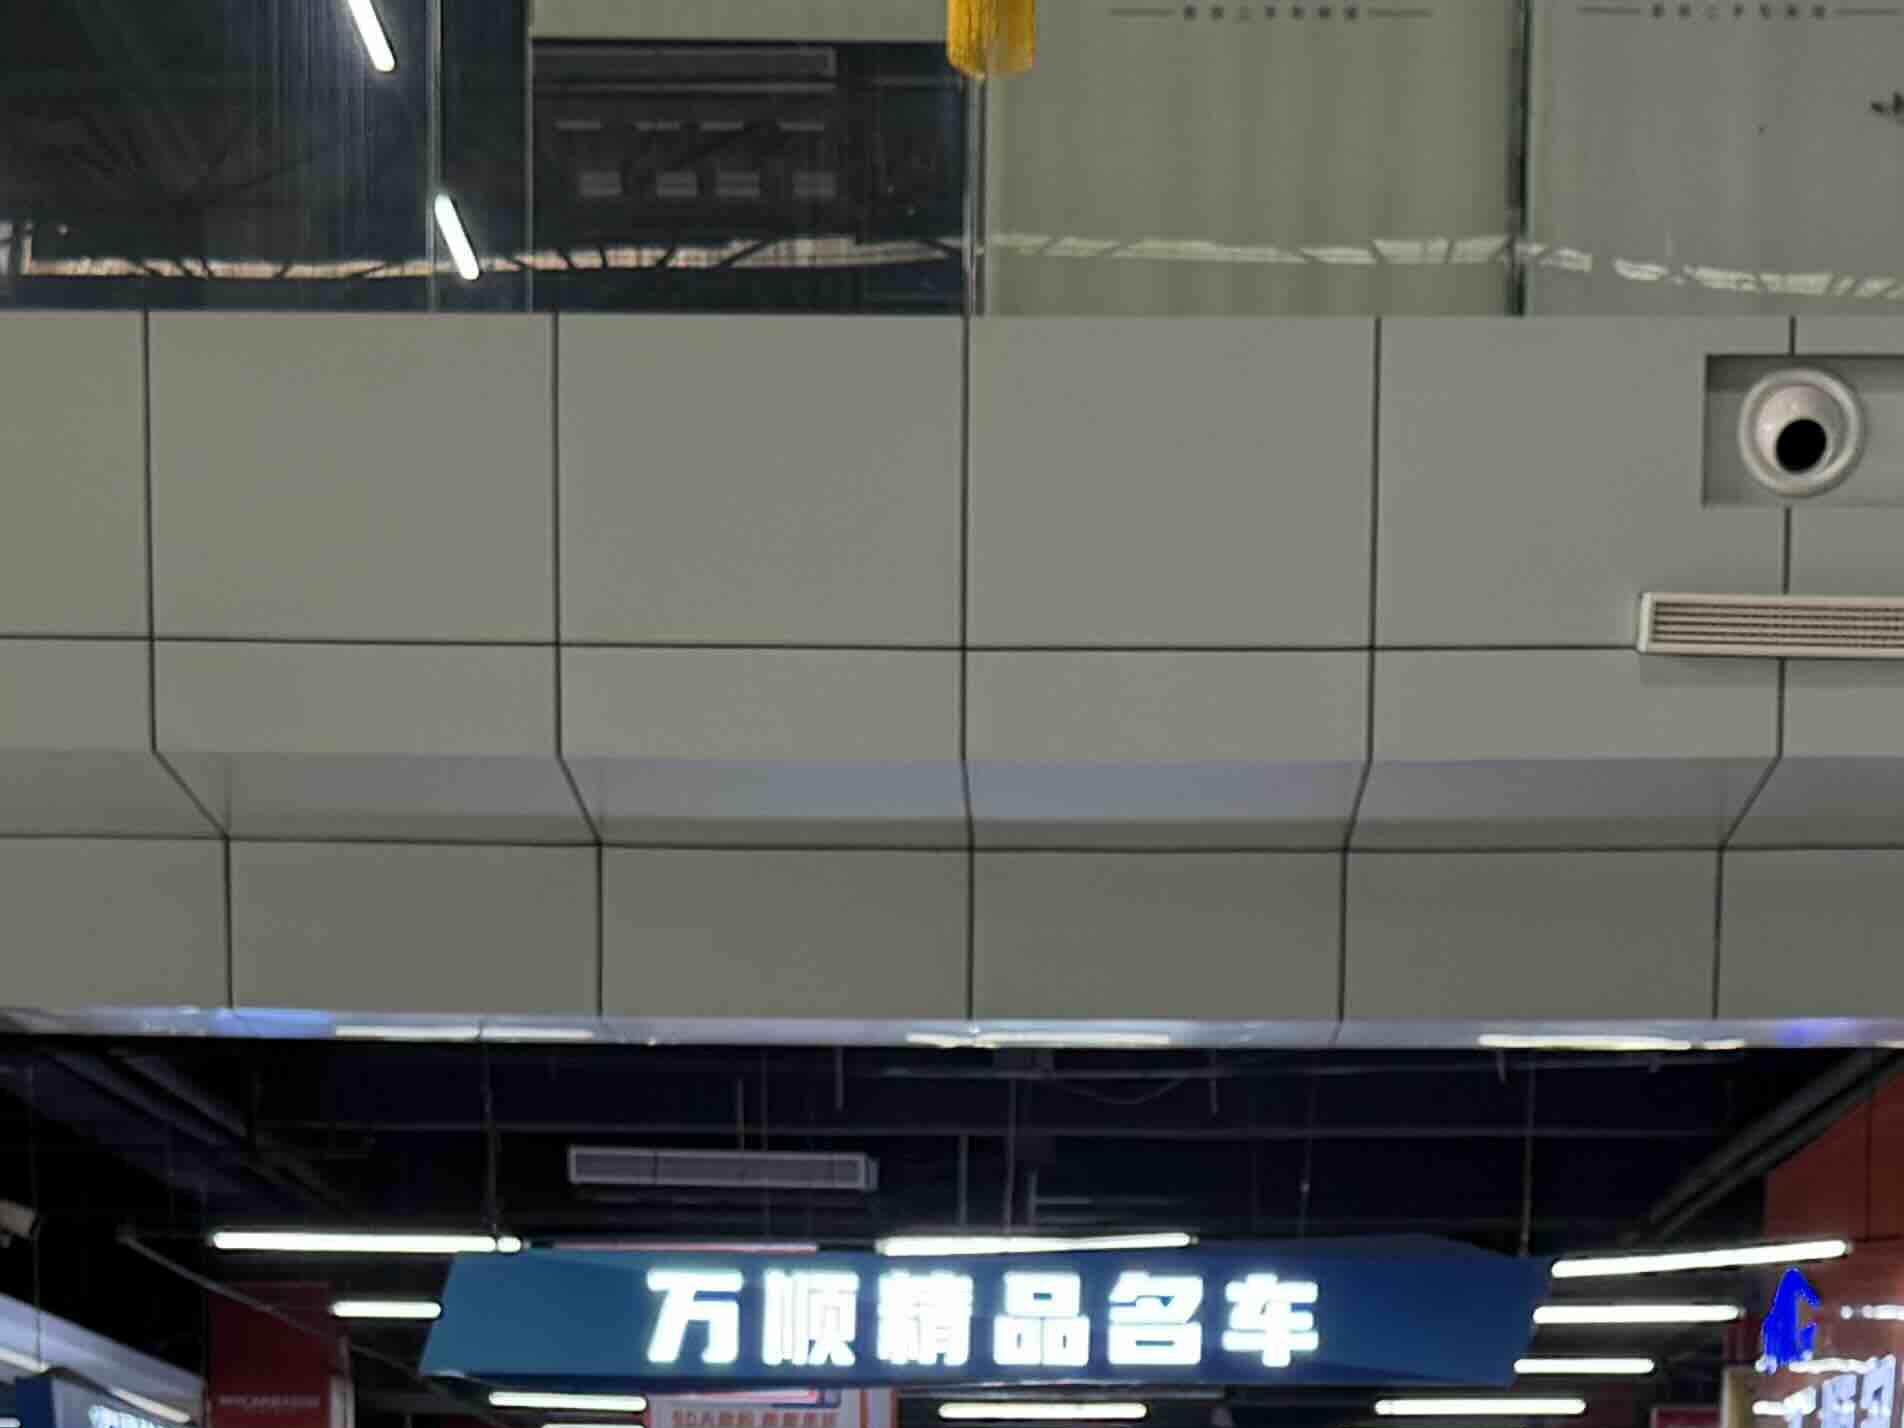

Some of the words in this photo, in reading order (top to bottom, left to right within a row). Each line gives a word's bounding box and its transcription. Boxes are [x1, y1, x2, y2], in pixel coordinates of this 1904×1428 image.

[646, 1268, 1321, 1368] 万顺精品名车
